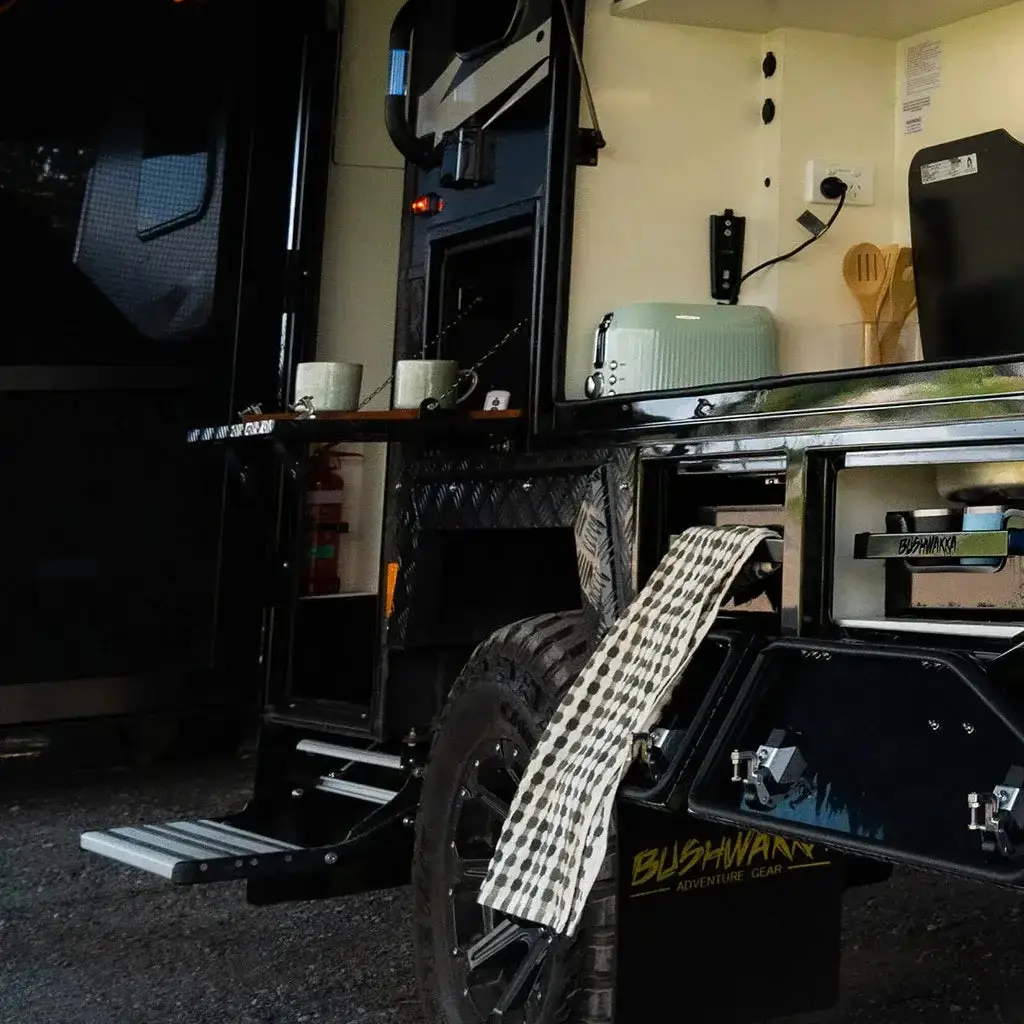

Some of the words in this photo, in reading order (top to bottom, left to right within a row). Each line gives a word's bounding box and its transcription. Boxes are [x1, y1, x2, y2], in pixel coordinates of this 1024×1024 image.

[899, 535, 956, 554] BUSHWAKKA
[676, 870, 744, 893] ADVENTURE
[751, 863, 783, 879] GEAR
